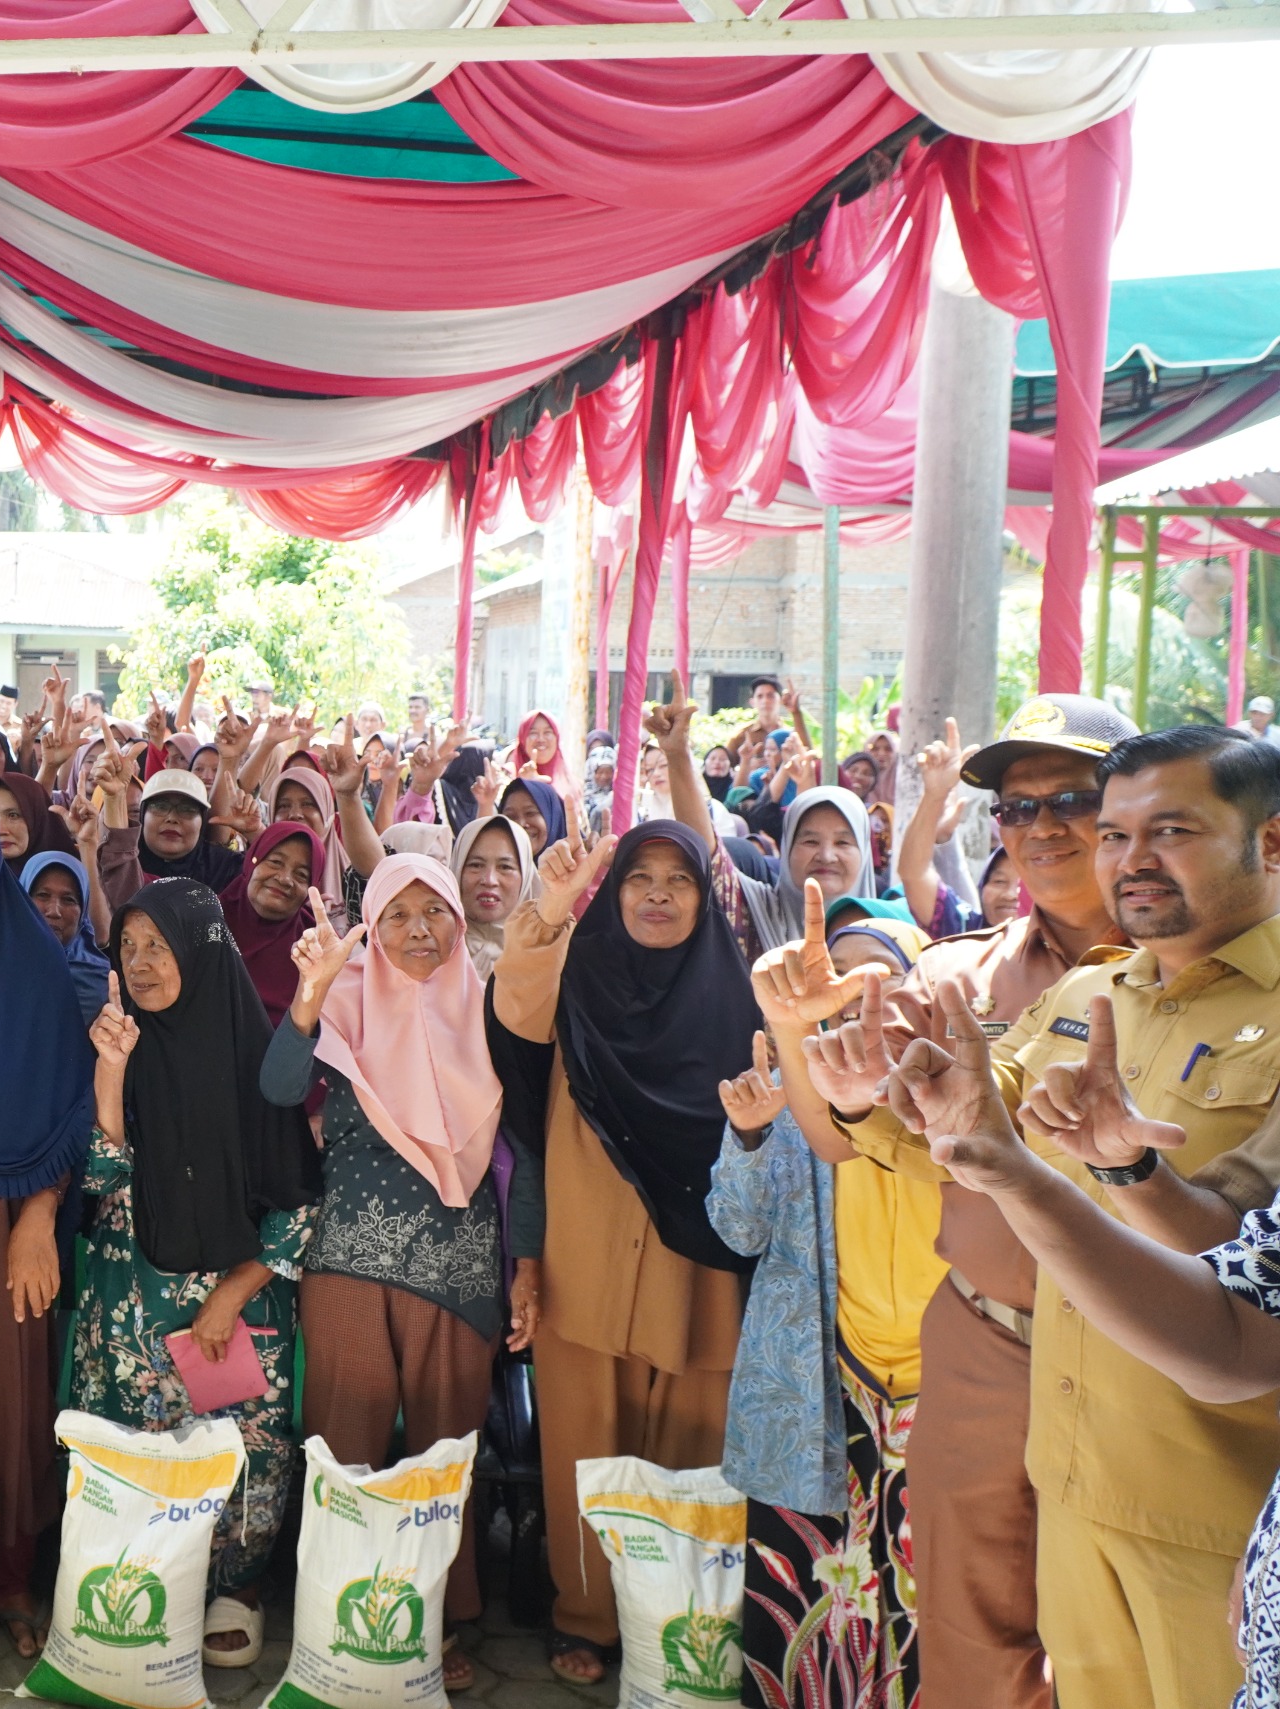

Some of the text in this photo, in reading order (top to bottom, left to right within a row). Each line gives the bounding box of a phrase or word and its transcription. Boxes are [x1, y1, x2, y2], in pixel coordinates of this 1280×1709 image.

[1057, 1020, 1089, 1036] IKHSA
[84, 1485, 113, 1505] PANGAN
[85, 1476, 110, 1494] BADAN
[82, 1494, 118, 1516] NASIONAL
[330, 1496, 362, 1517] PANGAN
[331, 1487, 358, 1506] BADAN
[329, 1505, 368, 1529] NASIONAL
[624, 1535, 656, 1543] BADAN
[75, 1607, 167, 1637] BANTUAN PANGAN
[334, 1623, 383, 1653] BANTUAN
[145, 1659, 173, 1672] BERAS
